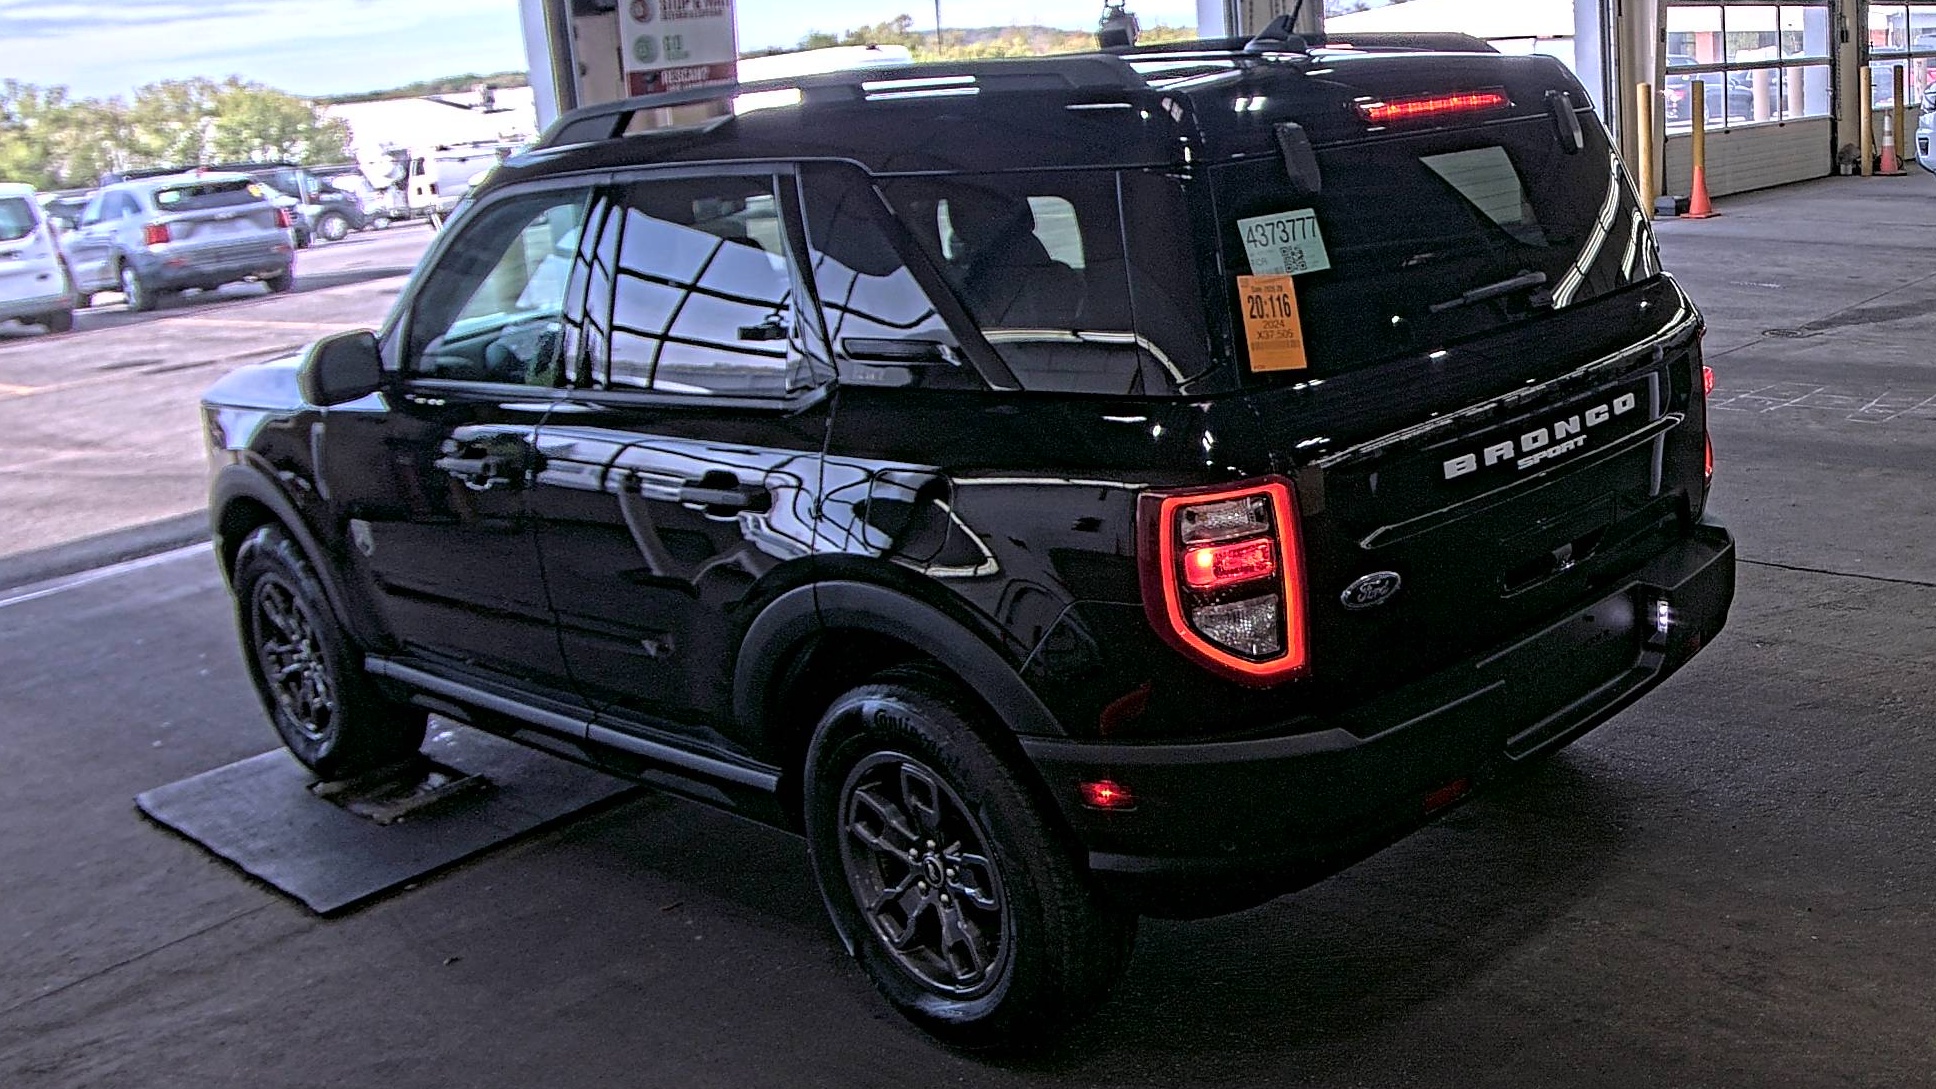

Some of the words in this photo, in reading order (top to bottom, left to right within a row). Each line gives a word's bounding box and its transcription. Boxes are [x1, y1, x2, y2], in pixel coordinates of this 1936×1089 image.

[1246, 215, 1317, 248] 4373777
[1247, 293, 1291, 319] 20:116
[1262, 320, 1285, 330] 2024
[1443, 392, 1636, 480] BRONCO
[1517, 434, 1588, 470] SPORT
[1357, 579, 1390, 603] Ford
